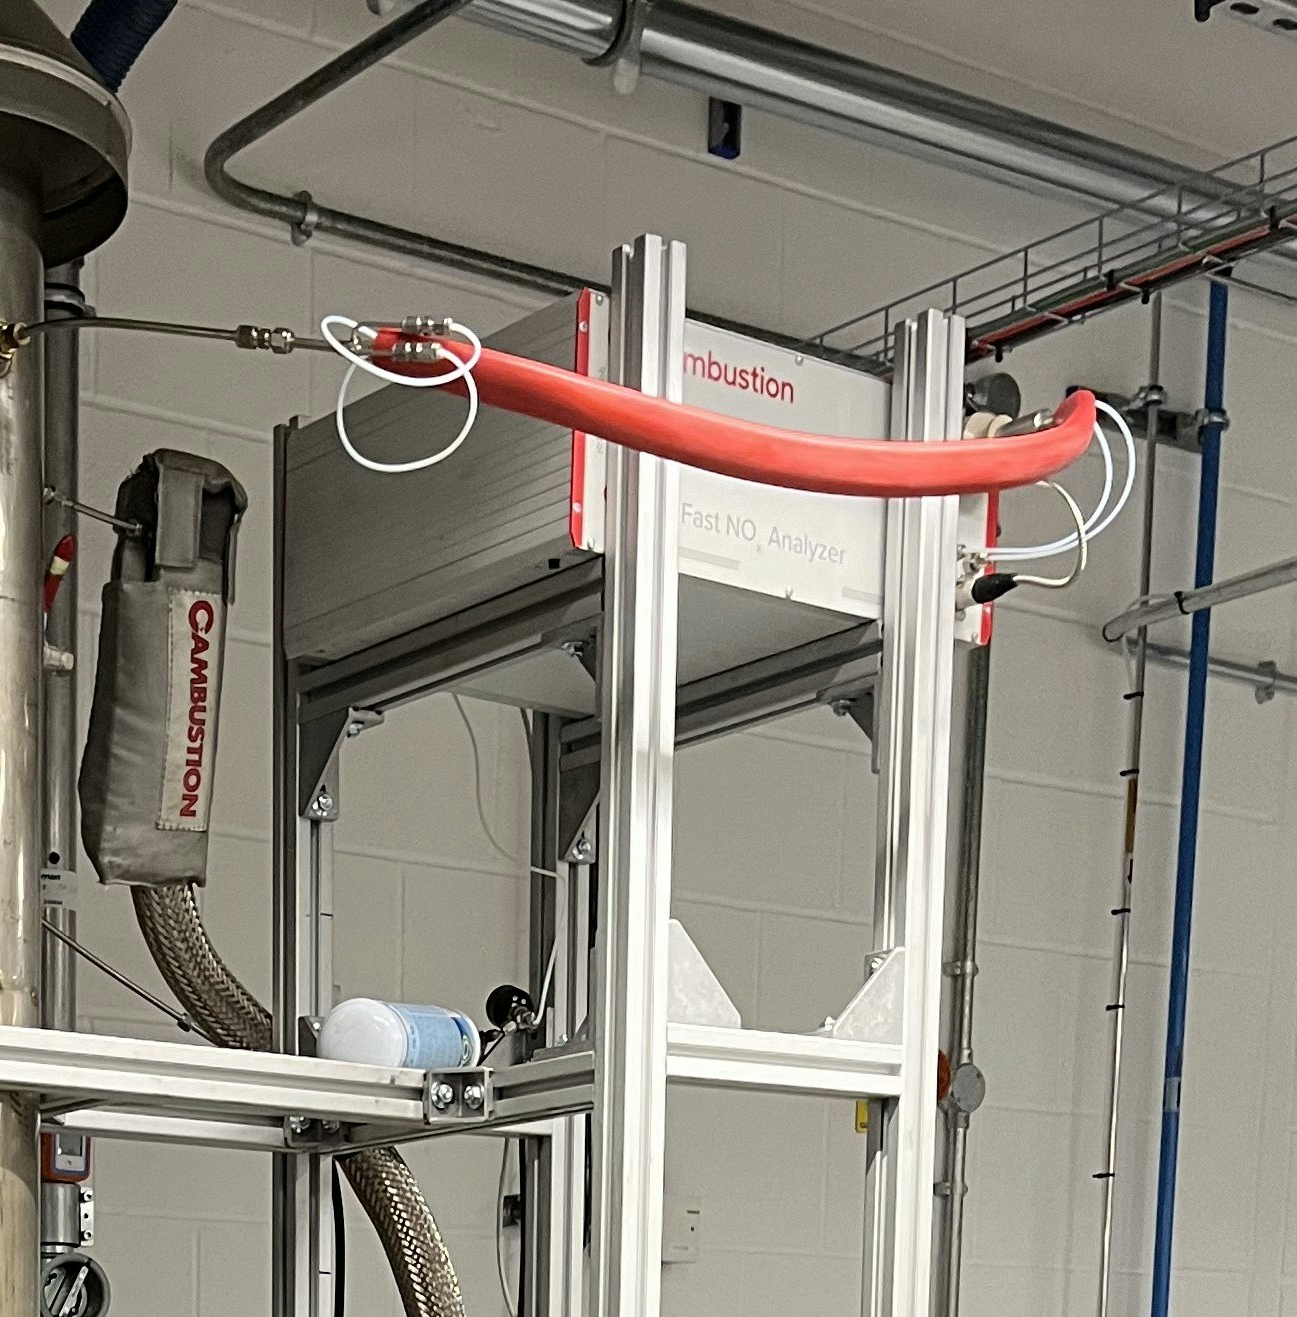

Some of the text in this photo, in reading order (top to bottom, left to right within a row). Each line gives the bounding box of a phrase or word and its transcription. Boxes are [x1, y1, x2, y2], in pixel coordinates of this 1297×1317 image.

[683, 350, 794, 403] mbustion
[681, 502, 721, 534] Fast
[767, 526, 846, 565] Analyzer
[179, 600, 215, 818] CAMBUSTION
